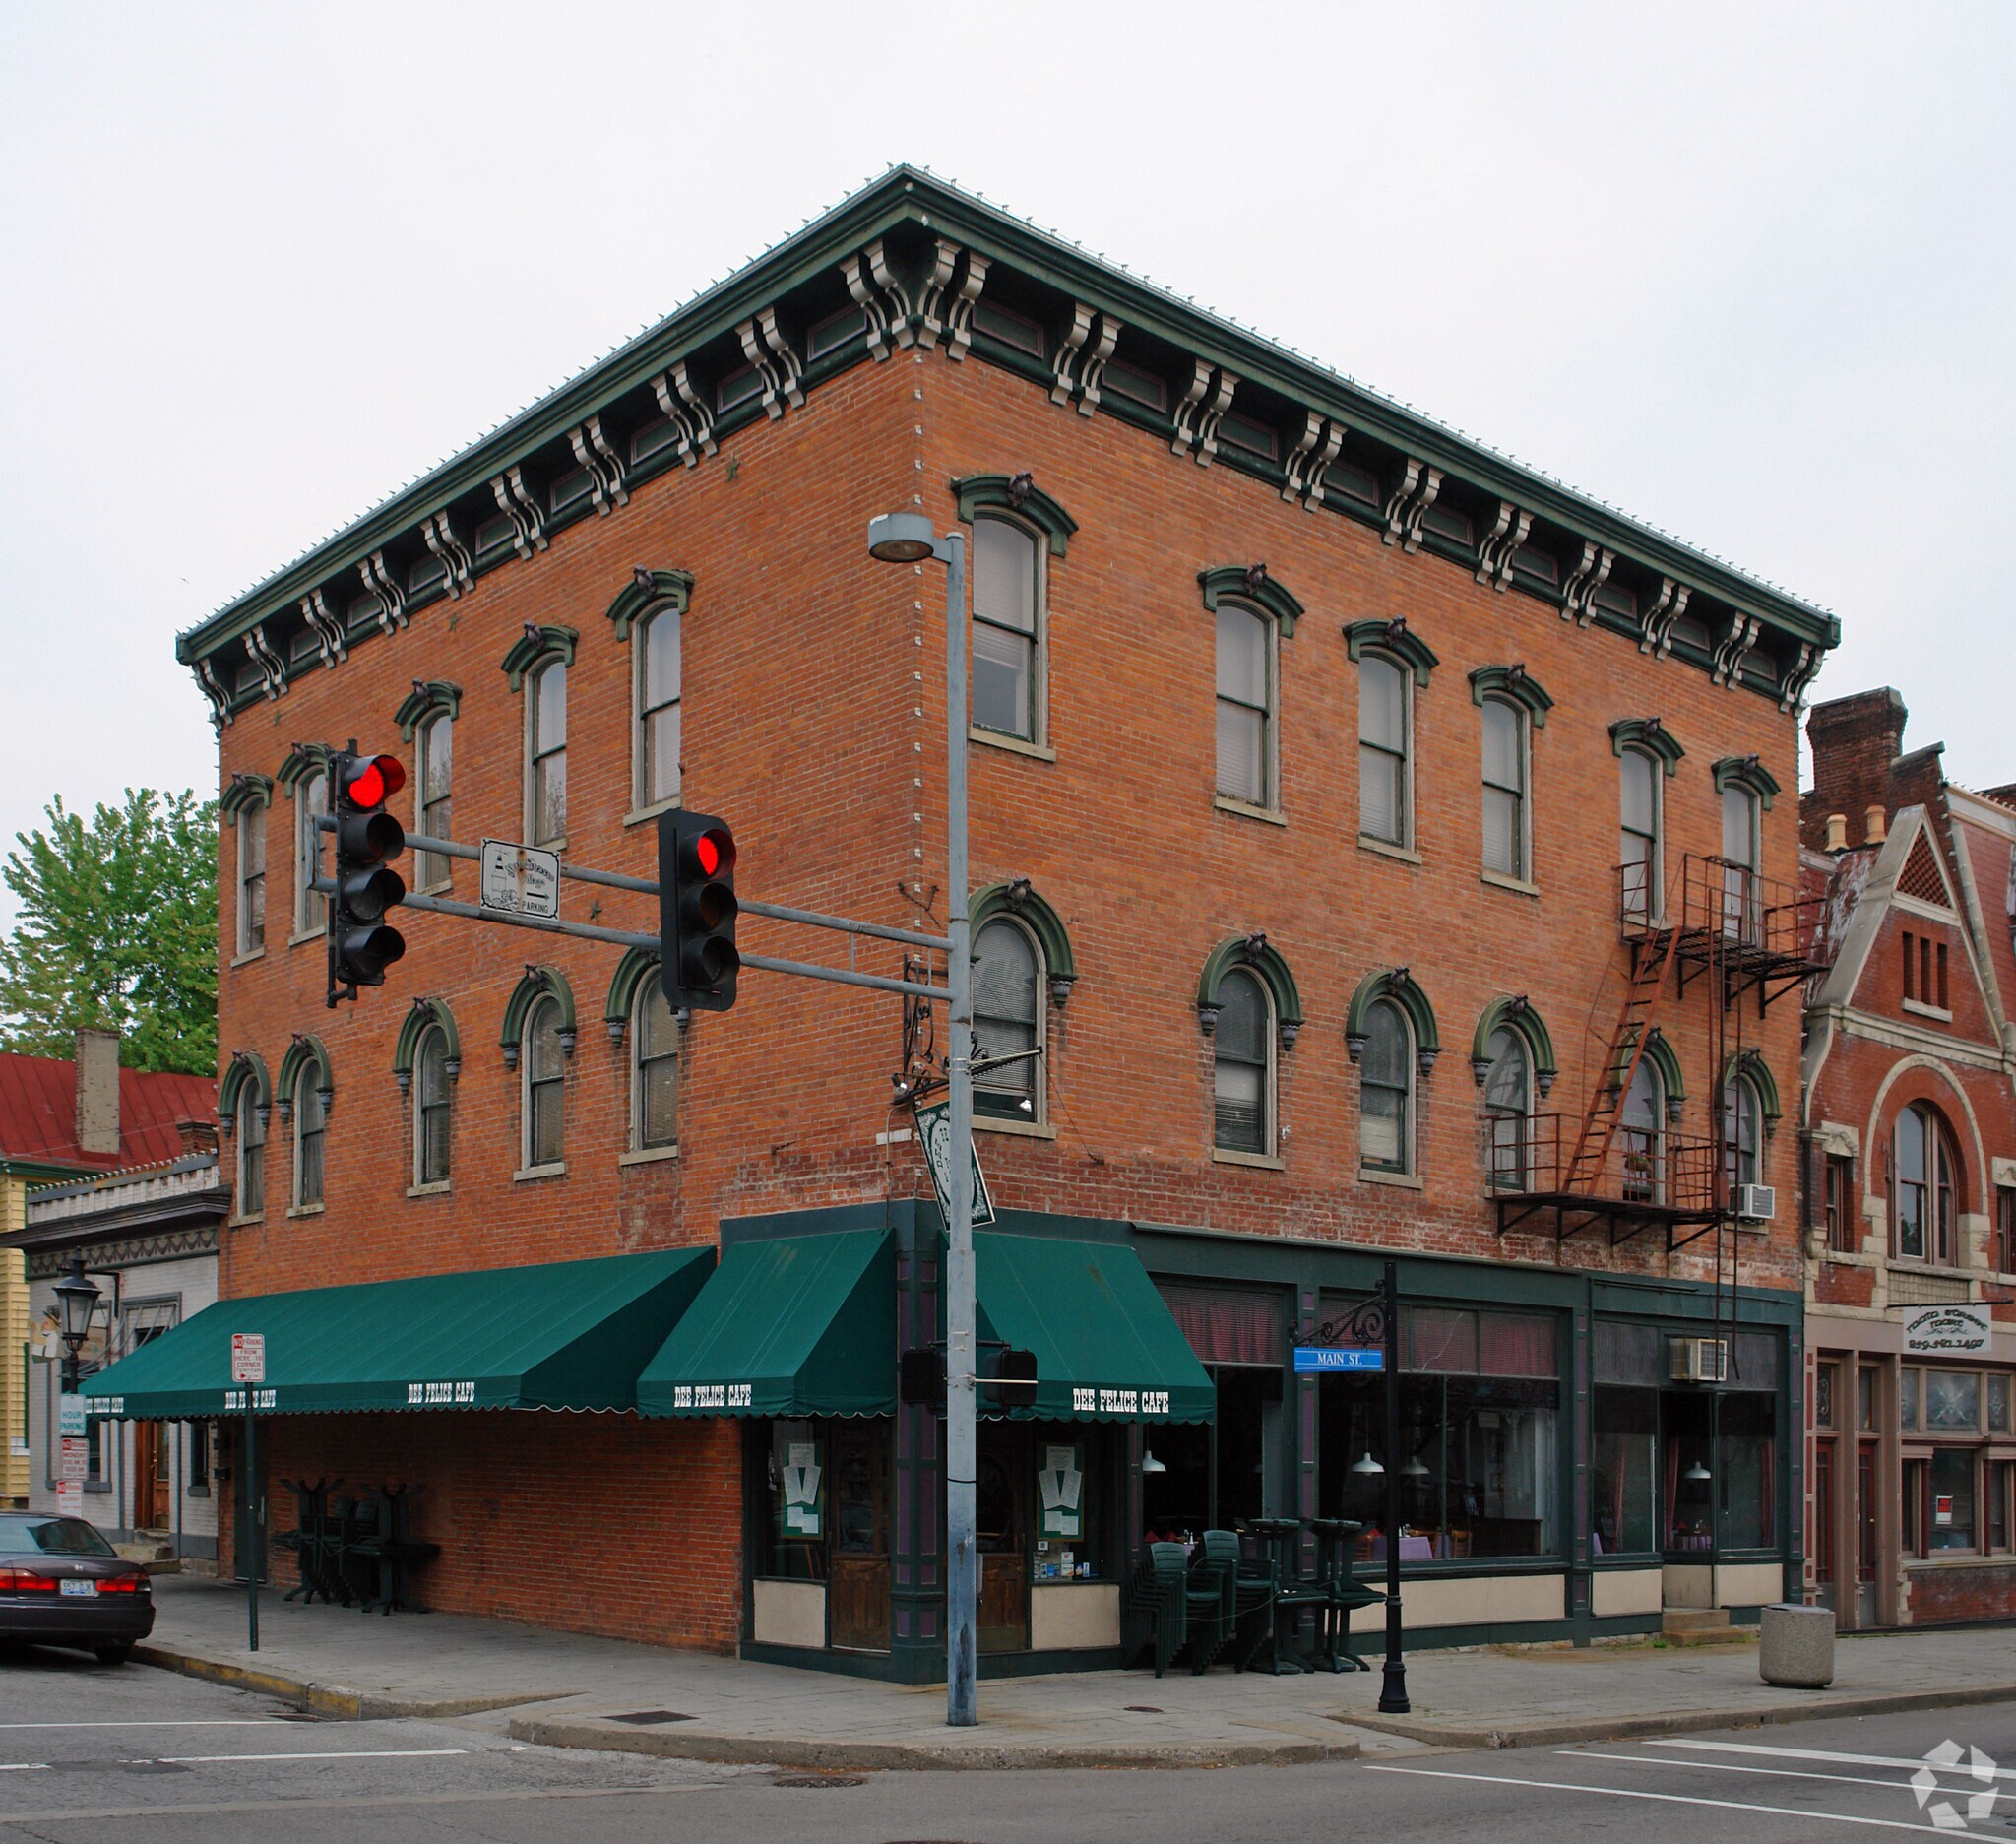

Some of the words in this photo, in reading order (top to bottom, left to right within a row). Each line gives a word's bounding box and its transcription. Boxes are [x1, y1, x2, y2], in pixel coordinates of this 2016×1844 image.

[522, 900, 549, 914] PARKING
[1317, 1353, 1345, 1365] MAIN
[1349, 1354, 1362, 1365] ST.
[408, 1383, 423, 1404] DEE
[425, 1382, 453, 1403] FELICE
[455, 1381, 475, 1402] CAFE
[674, 1386, 692, 1408] DEE
[694, 1385, 725, 1407] FELICE
[727, 1384, 752, 1406] CAFE
[1073, 1388, 1096, 1412] DEE
[1100, 1389, 1138, 1413] FELICE
[1142, 1391, 1169, 1413] CAFE
[62, 1410, 82, 1419] HOUR
